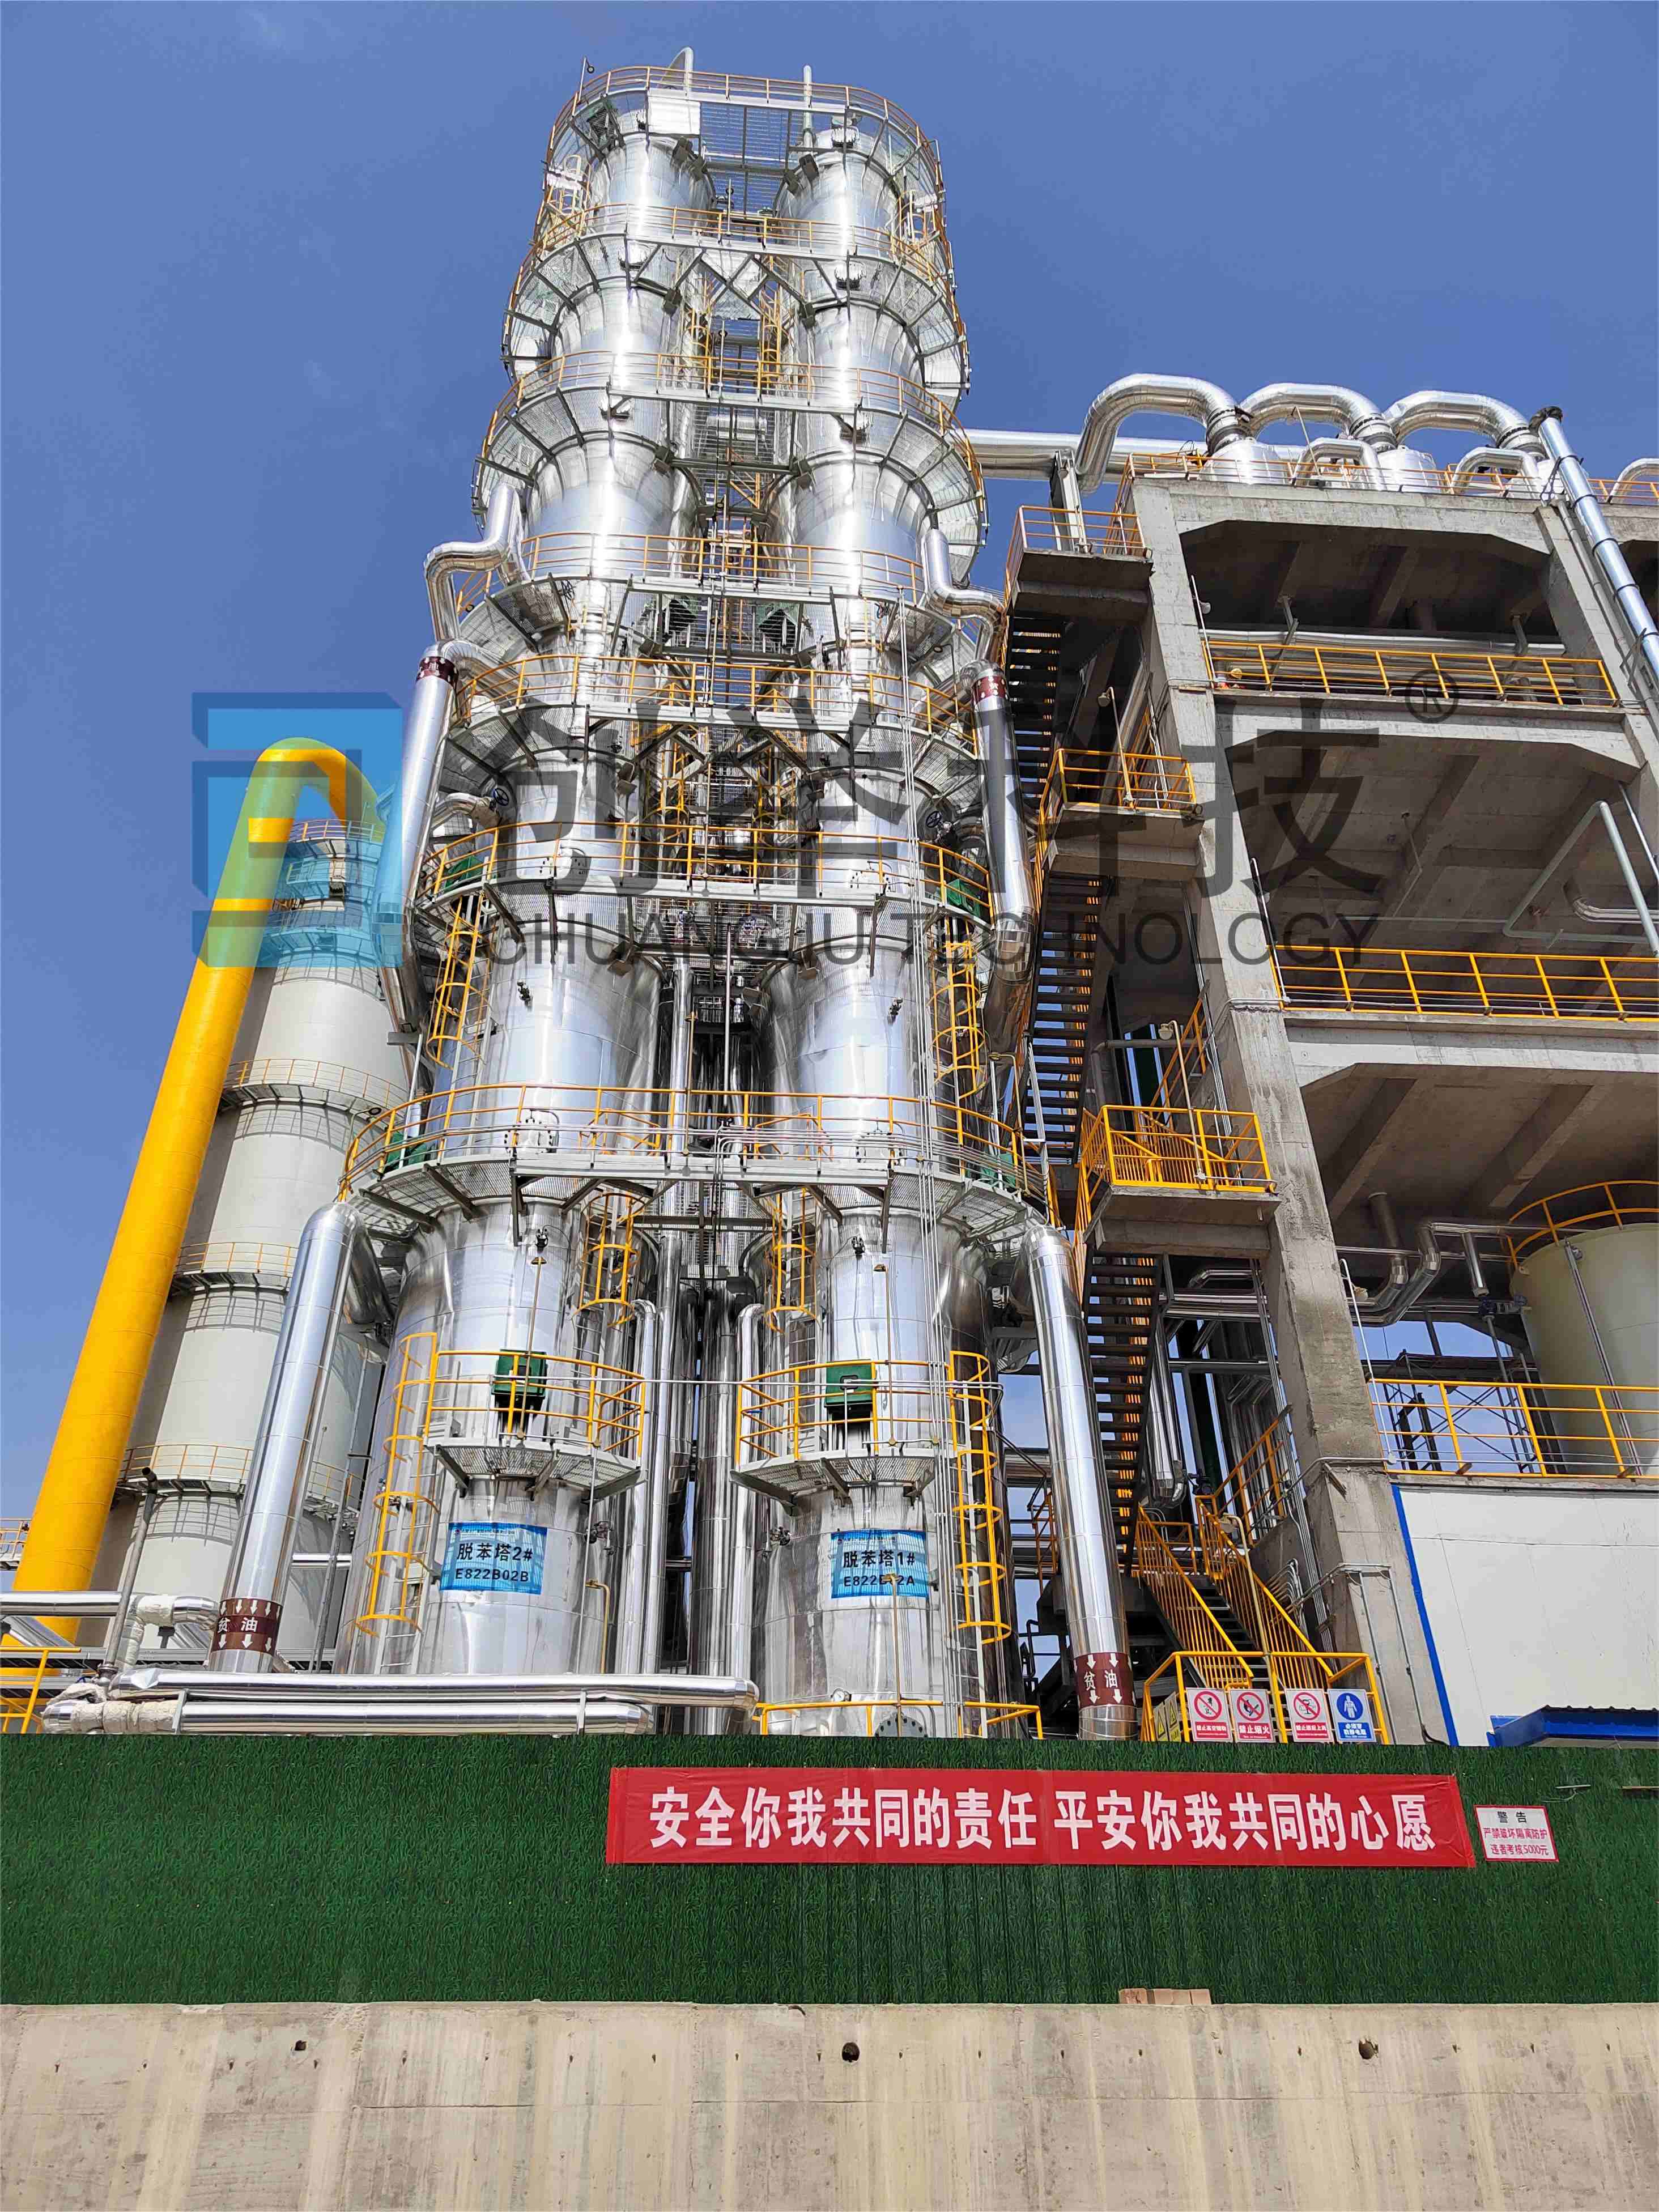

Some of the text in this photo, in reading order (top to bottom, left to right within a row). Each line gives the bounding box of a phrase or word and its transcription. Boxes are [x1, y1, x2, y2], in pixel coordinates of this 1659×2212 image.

[457, 1542, 534, 1562] 脱苯塔2#
[843, 1549, 916, 1568] 脱苯塔1#
[455, 1568, 529, 1582] E822B02B
[844, 1575, 915, 1587] E822B2A
[1083, 1669, 1118, 1691] 贫油
[649, 1786, 1436, 1851] 安全你我共同的责任 平安你我共同的心愿
[1497, 1811, 1528, 1824] 警告
